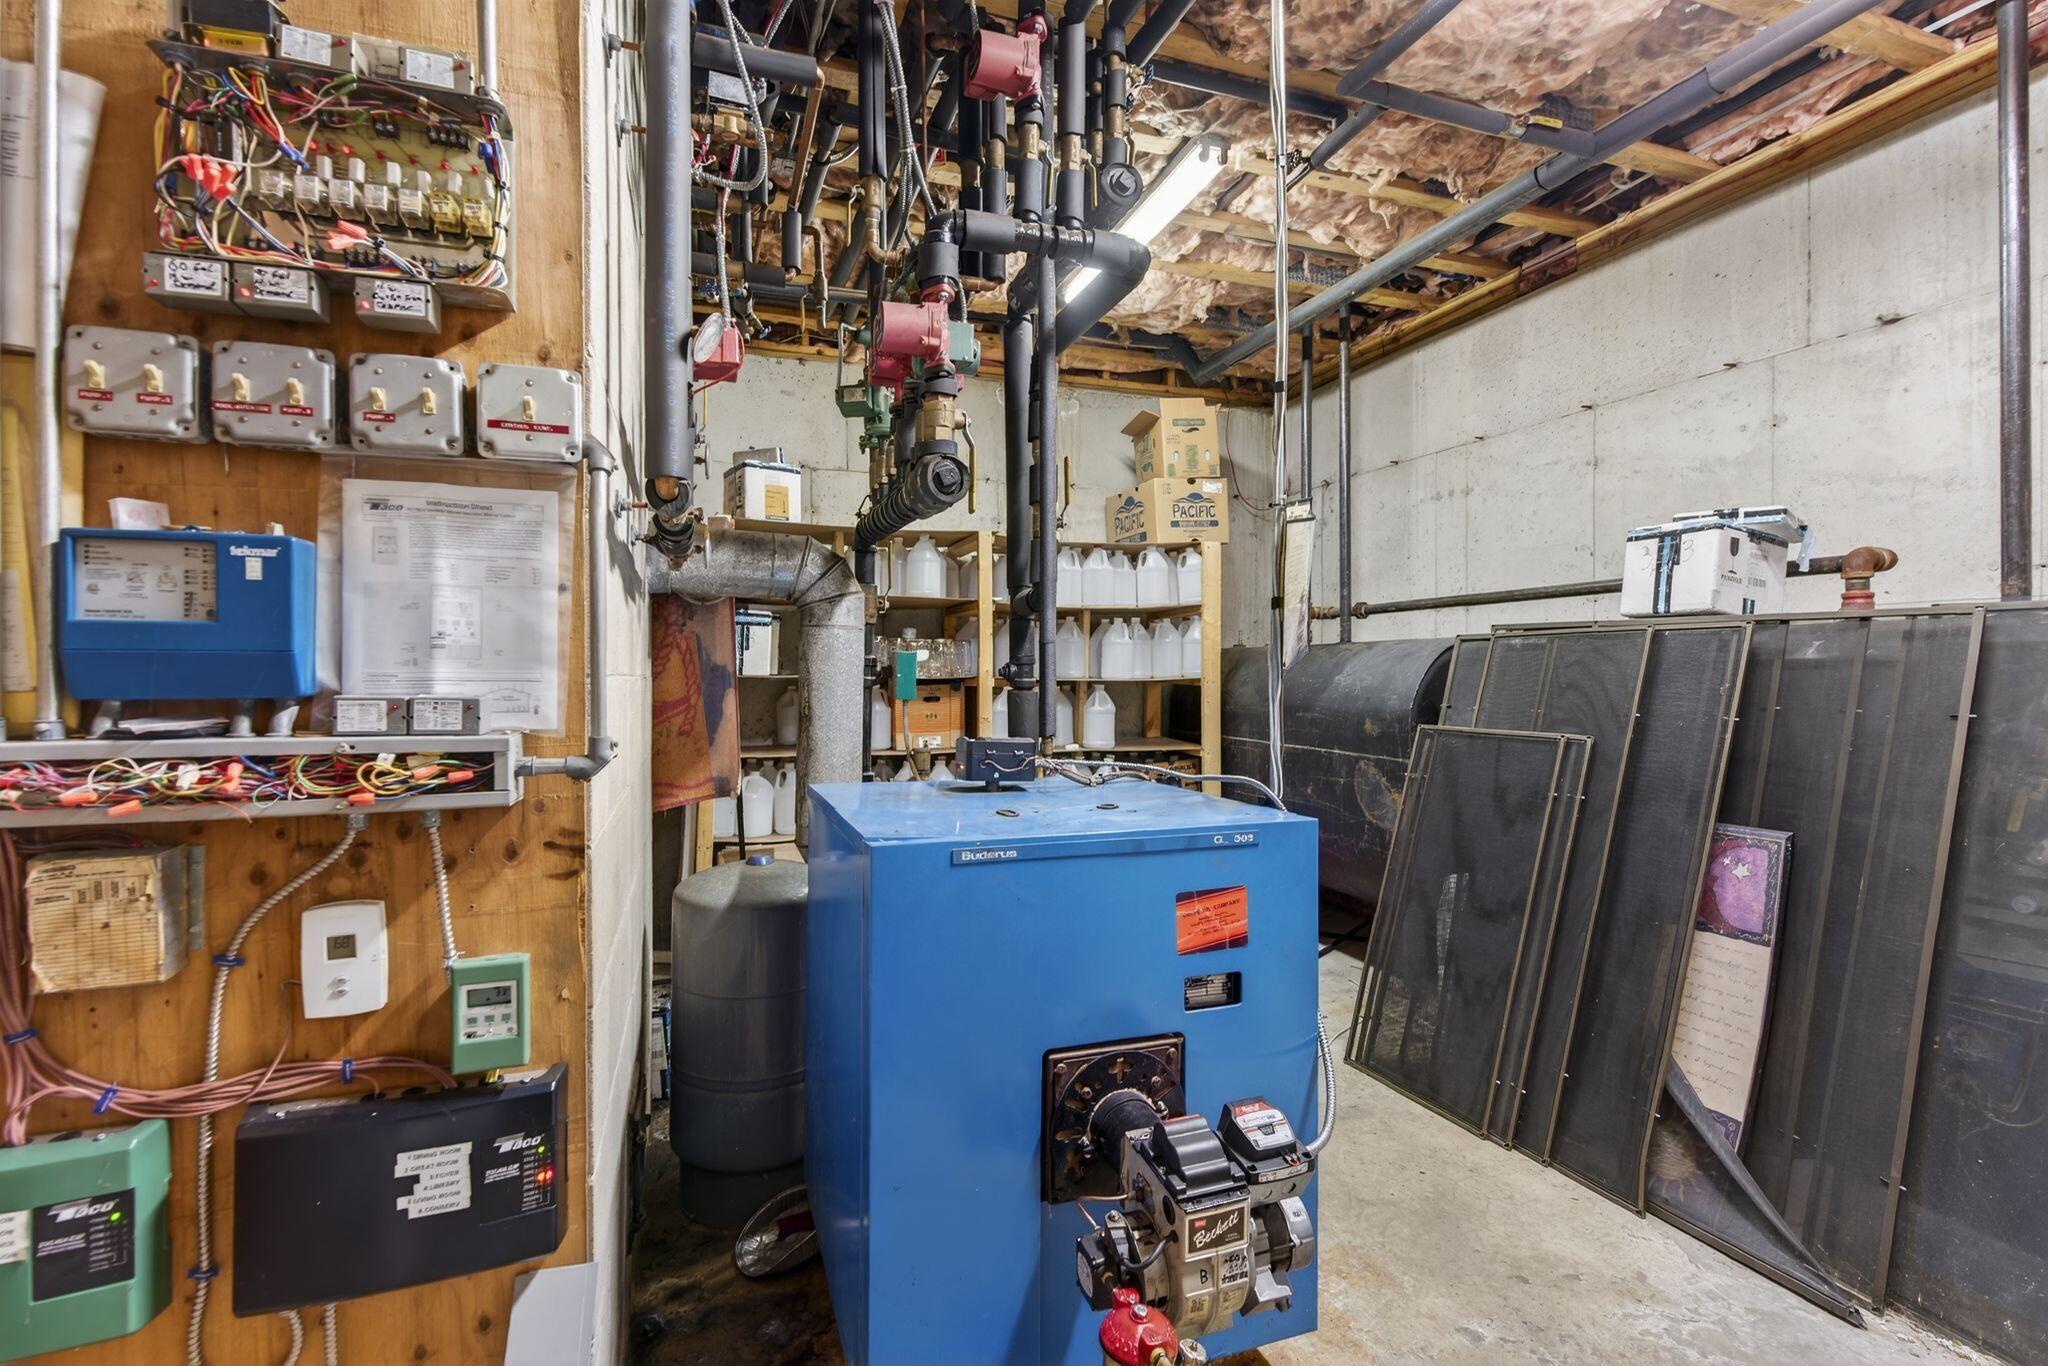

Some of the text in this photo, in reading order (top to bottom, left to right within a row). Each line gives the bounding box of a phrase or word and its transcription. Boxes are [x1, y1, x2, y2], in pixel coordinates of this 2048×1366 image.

[1172, 504, 1216, 518] PACIFIC
[1114, 511, 1145, 535] PACIFIC
[961, 850, 1018, 861] Buderus
[1193, 1210, 1240, 1249] Beckett
[1200, 1269, 1209, 1285] B
